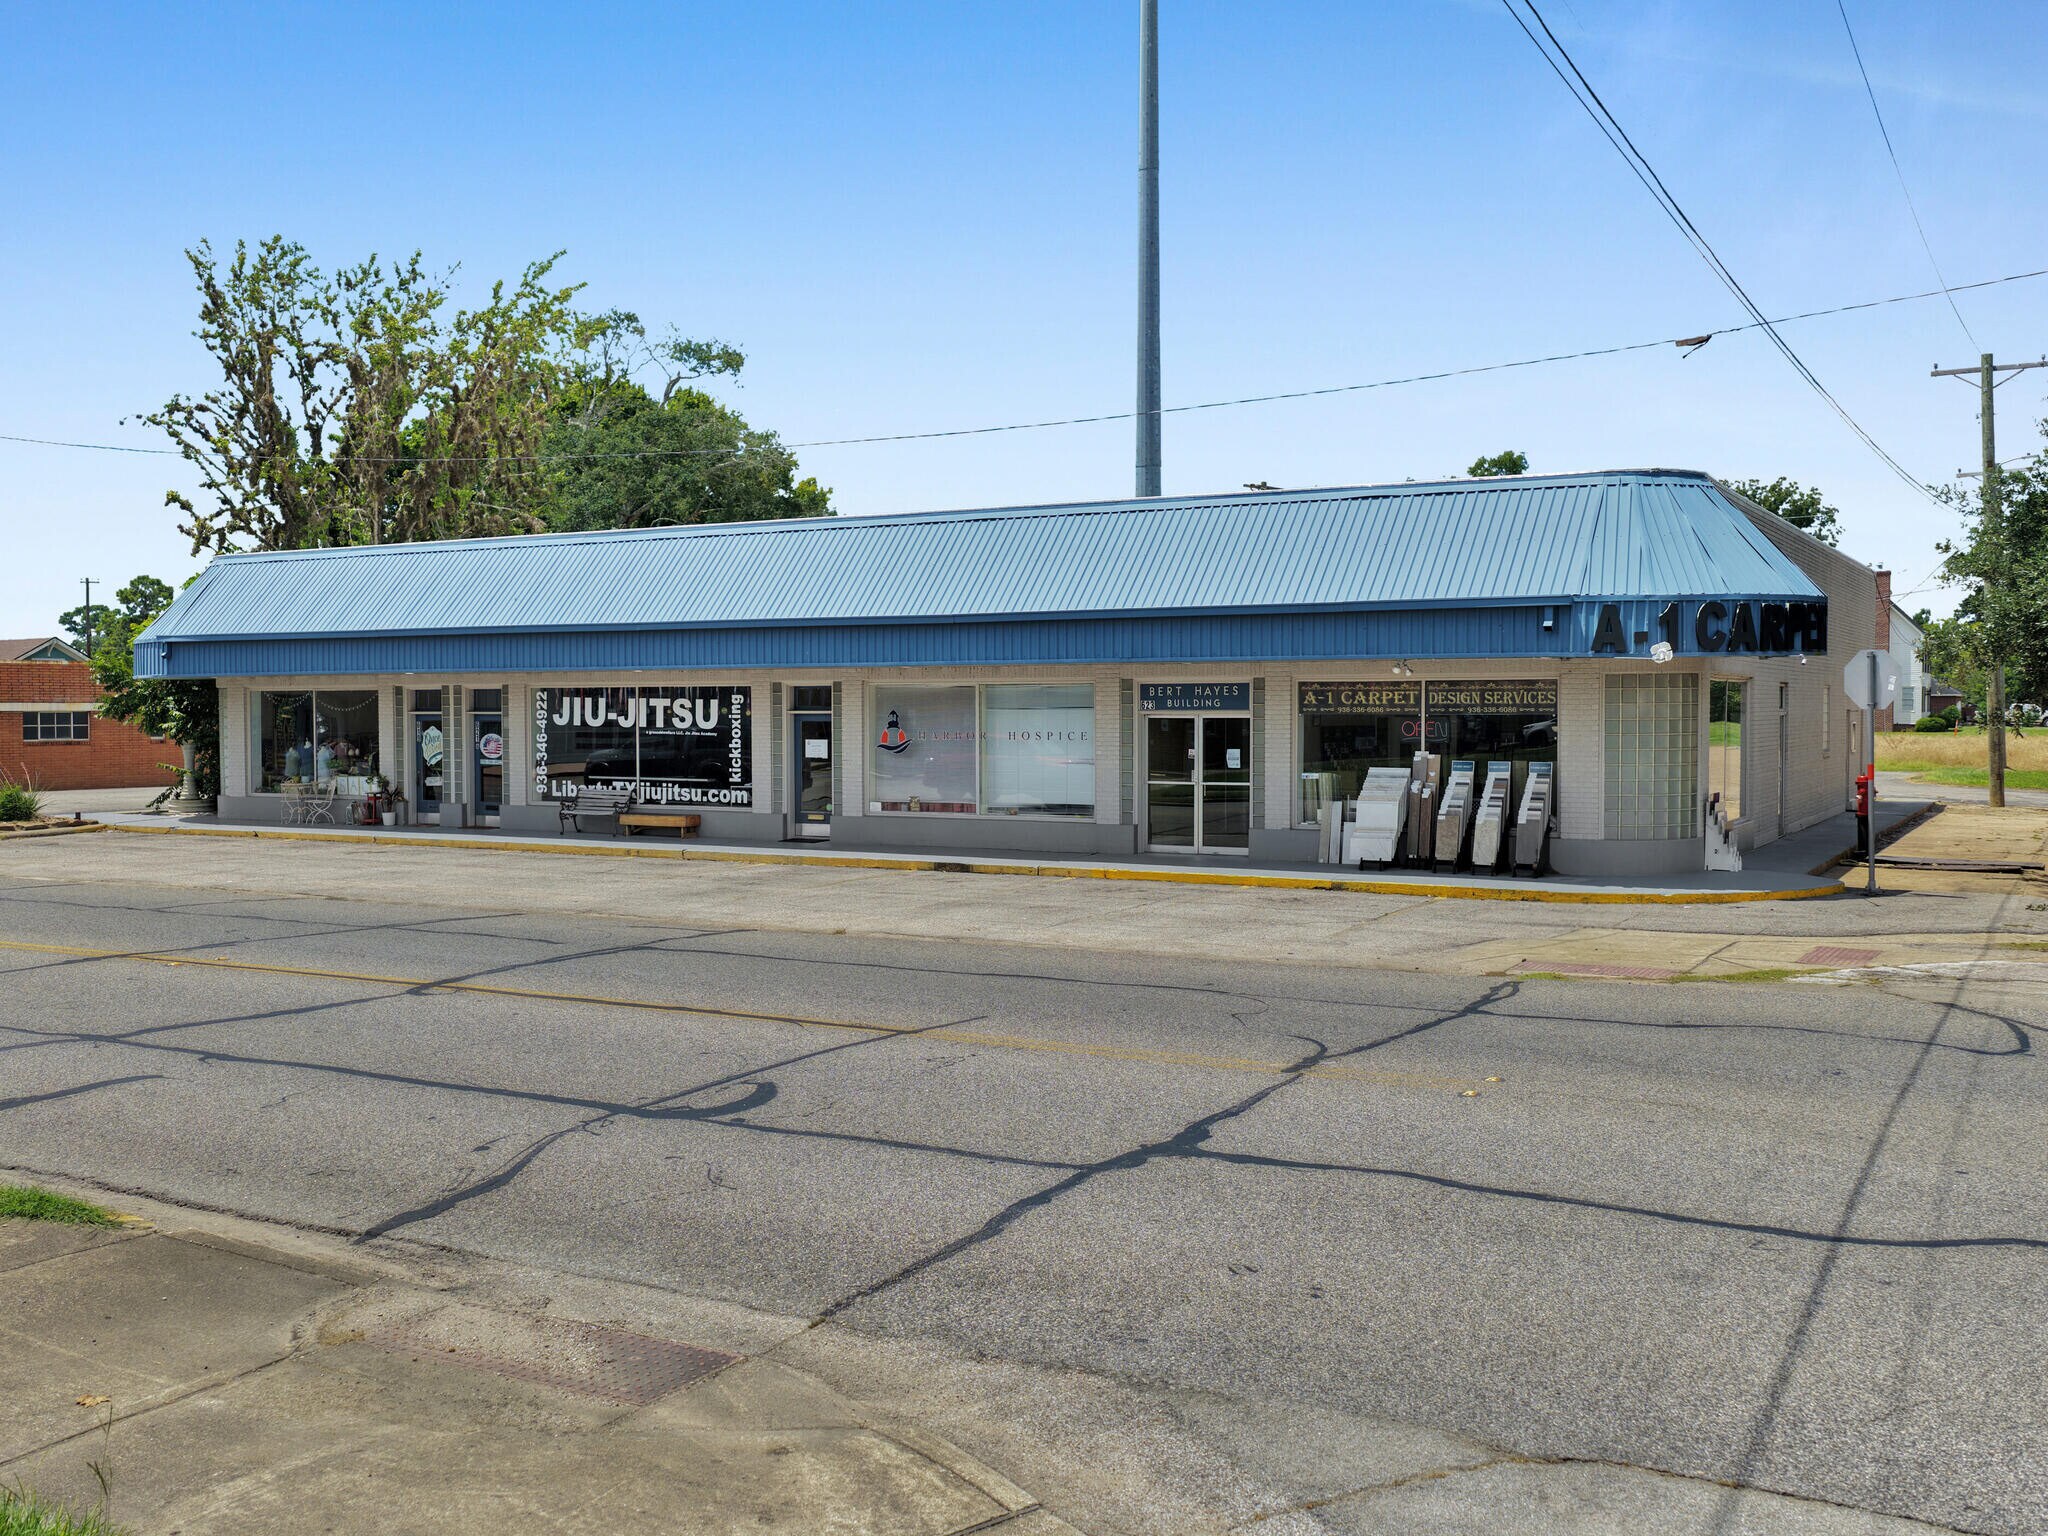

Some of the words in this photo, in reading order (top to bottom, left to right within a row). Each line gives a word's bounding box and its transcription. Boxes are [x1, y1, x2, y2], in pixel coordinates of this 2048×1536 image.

[1590, 601, 1680, 653] A-1
[1149, 686, 1182, 697] BERT
[1194, 685, 1239, 696] HAYES
[1303, 691, 1334, 704] A-1
[1341, 691, 1419, 705] CARPET
[1428, 691, 1481, 705] DESIGN
[1484, 690, 1557, 704] SERVICES
[1167, 698, 1221, 707] BUILDING
[552, 697, 719, 730] JIU-JITSU
[917, 730, 987, 741] HARBOR
[1008, 730, 1089, 741] HOSPICE
[1401, 720, 1448, 738] OPEN
[536, 690, 548, 793] 936-346-4922
[728, 694, 744, 783] kickboxing
